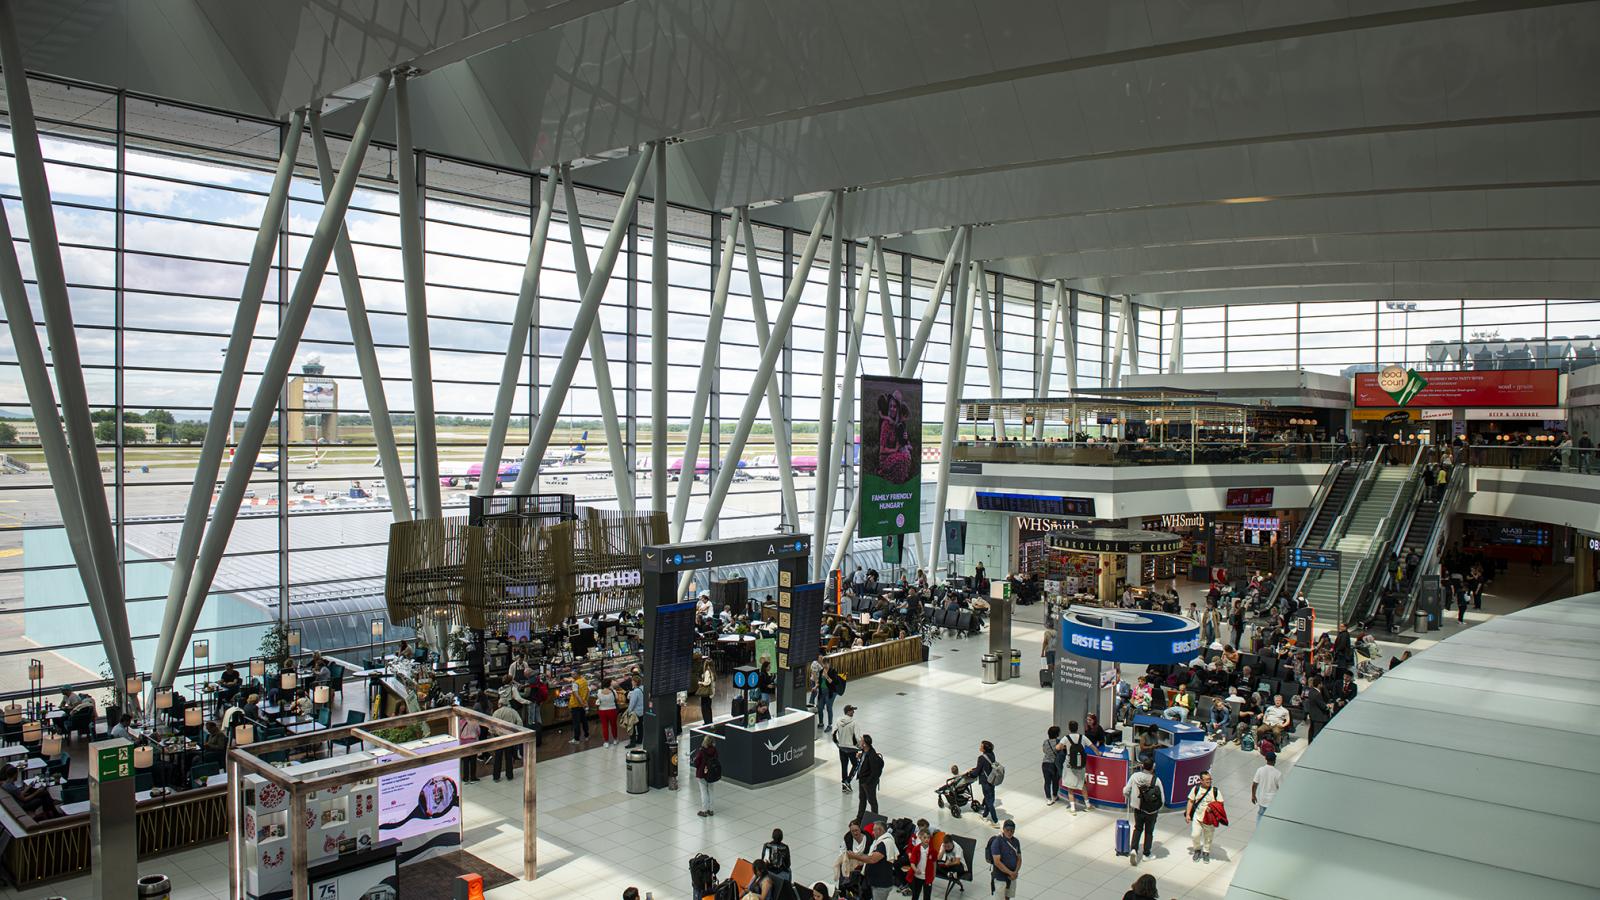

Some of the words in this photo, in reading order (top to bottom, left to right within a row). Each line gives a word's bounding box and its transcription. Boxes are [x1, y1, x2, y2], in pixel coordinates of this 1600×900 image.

[1381, 369, 1402, 379] food
[1381, 379, 1404, 387] court
[871, 494, 889, 502] FAMILY
[1016, 516, 1079, 532] WHSmith
[1162, 512, 1205, 527] WHSmith
[767, 544, 775, 555] A
[705, 550, 713, 562] B
[1071, 634, 1100, 649] ERSTE
[1073, 673, 1092, 681] believes
[771, 746, 793, 766] bud
[318, 883, 336, 898] 75
